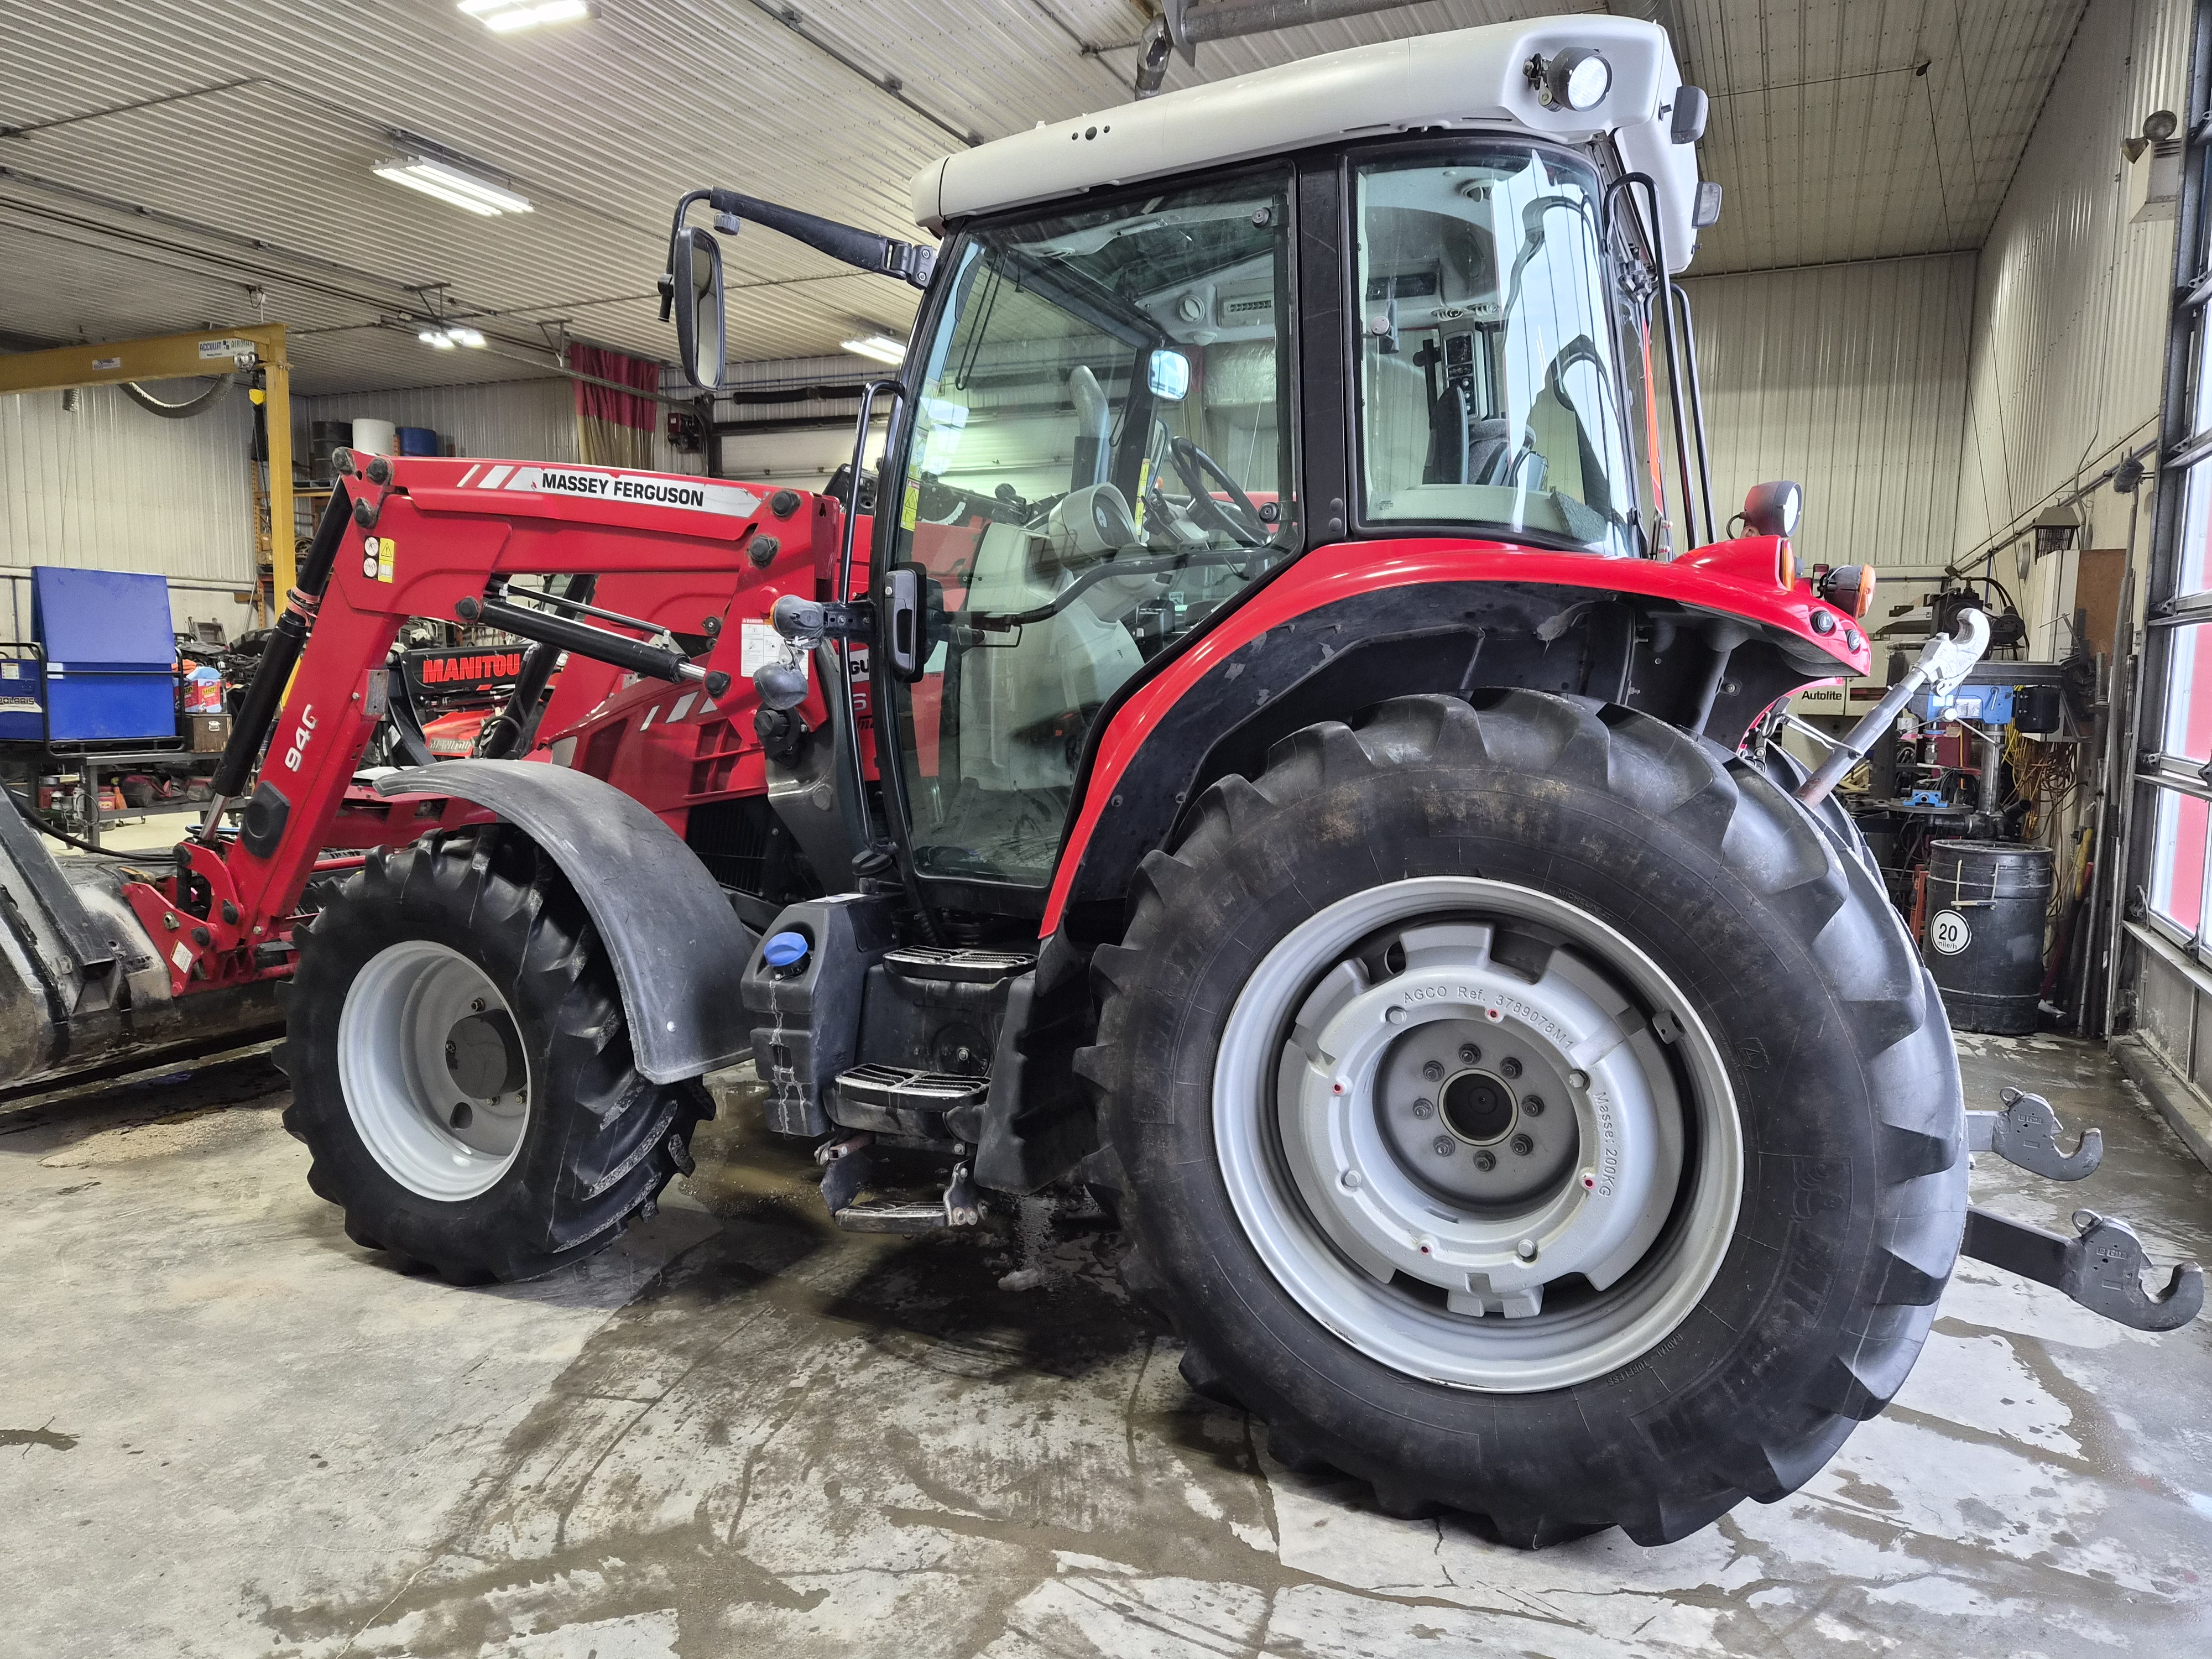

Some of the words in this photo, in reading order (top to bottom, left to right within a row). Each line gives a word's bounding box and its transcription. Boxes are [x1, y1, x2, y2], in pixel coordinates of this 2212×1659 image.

[542, 473, 609, 494] MASSEY
[613, 481, 704, 507] FERGUSON
[423, 654, 520, 683] MANITOU
[1801, 691, 1842, 700] Autolite
[1937, 941, 1957, 950] mile/h
[1938, 923, 1958, 942] 20
[1403, 985, 1447, 1004] AGCO
[1458, 986, 1486, 1002] Ref.
[1495, 995, 1574, 1050] 3789078M1
[1594, 1092, 1615, 1144] Masse:
[1599, 1149, 1618, 1197] 200KG
